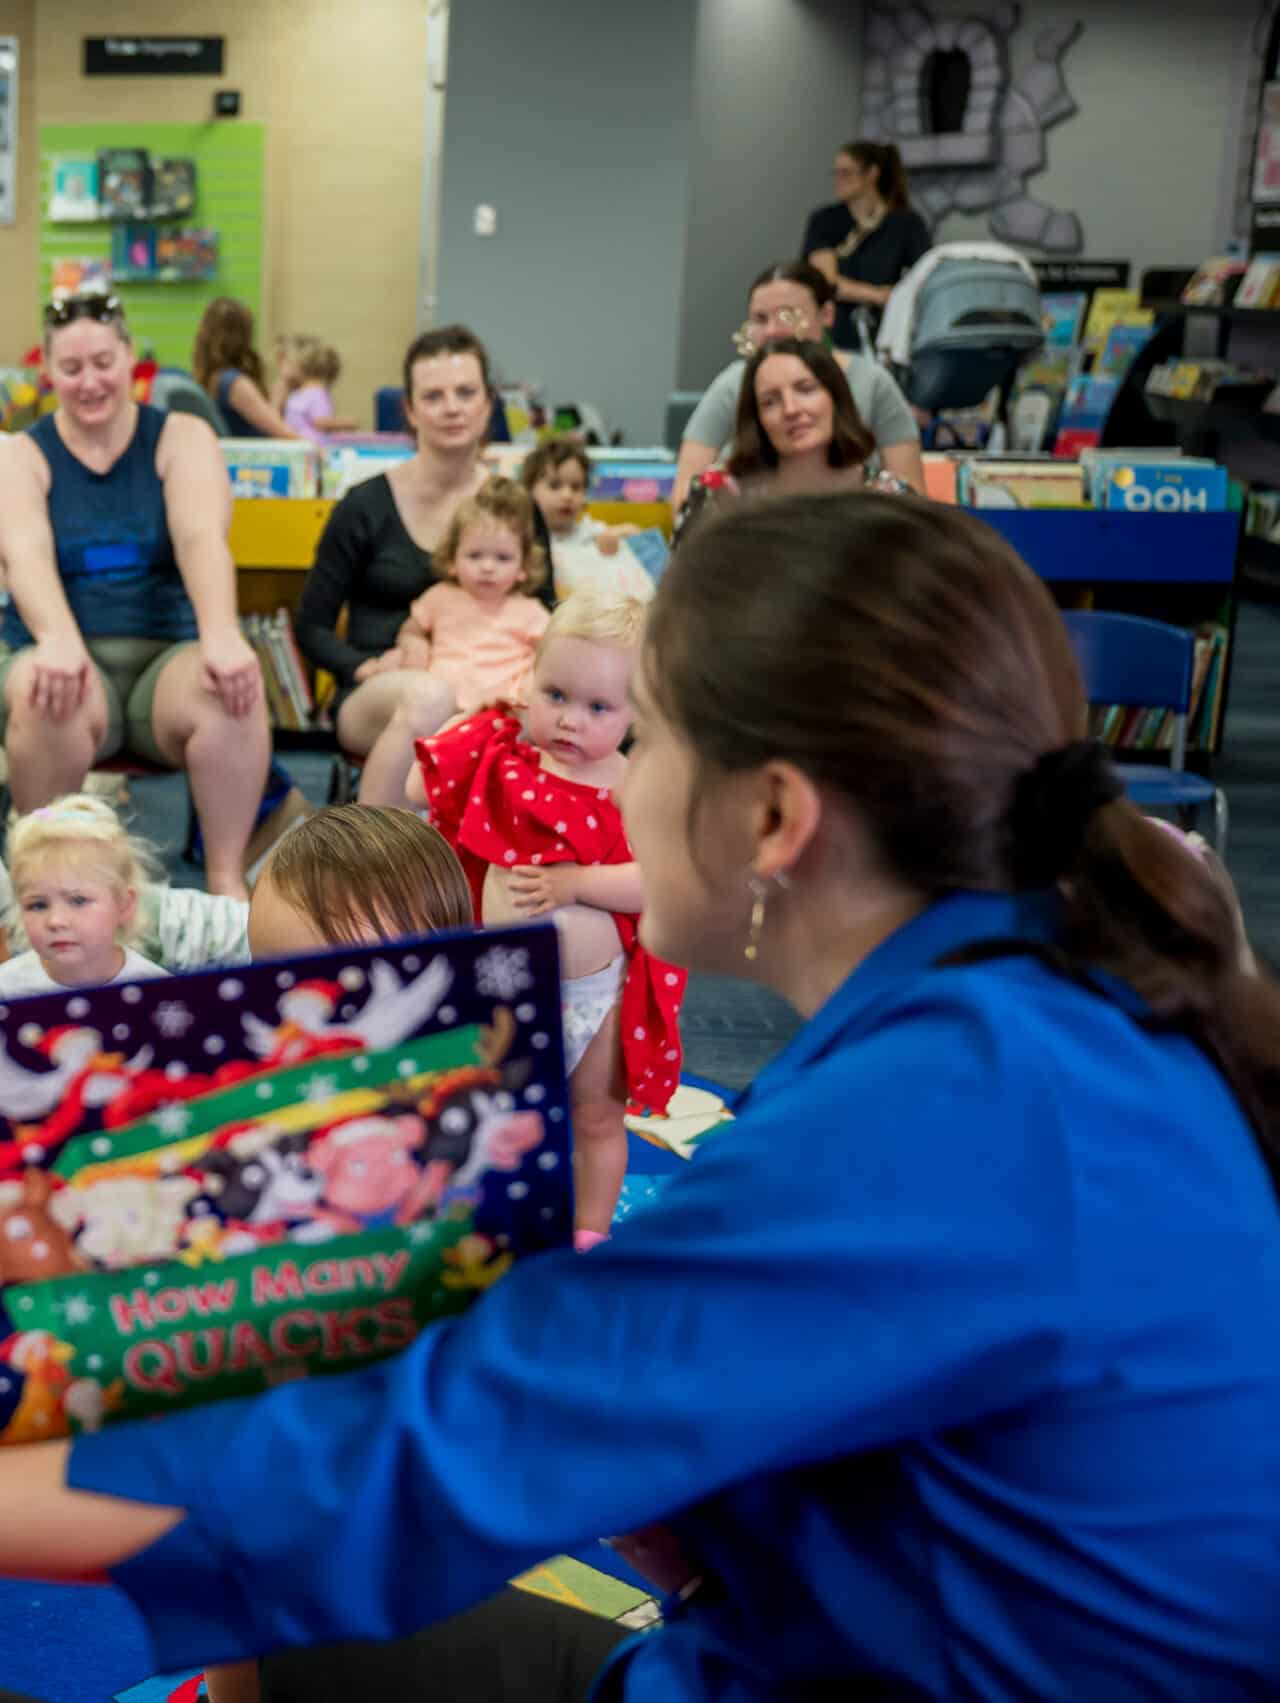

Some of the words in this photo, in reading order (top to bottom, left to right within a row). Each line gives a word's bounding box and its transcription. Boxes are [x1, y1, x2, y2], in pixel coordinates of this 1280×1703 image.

[109, 1278, 236, 1335] How
[251, 1250, 410, 1307] Many
[124, 1297, 418, 1392] QUACKS
